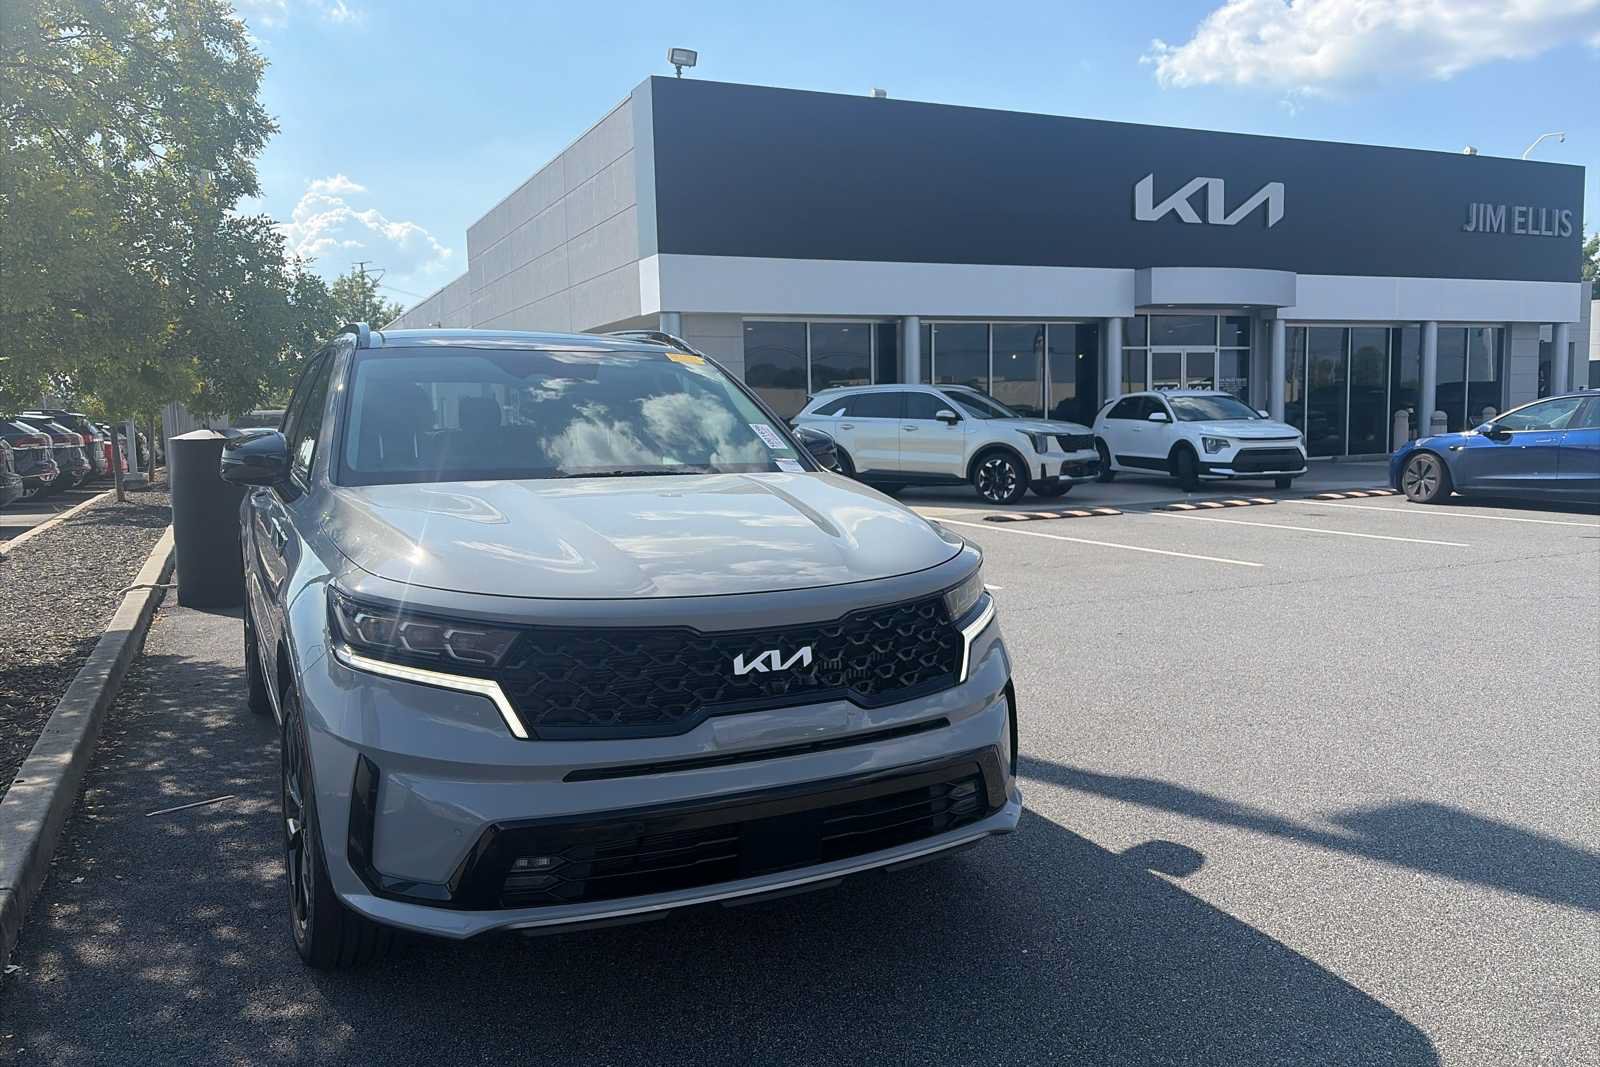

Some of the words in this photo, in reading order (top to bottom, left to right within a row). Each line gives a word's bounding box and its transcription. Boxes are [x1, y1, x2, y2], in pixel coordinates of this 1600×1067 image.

[1135, 172, 1285, 228] KIA
[1463, 202, 1507, 233] JIM
[1512, 206, 1573, 238] ELLIS
[733, 646, 813, 676] KIA
